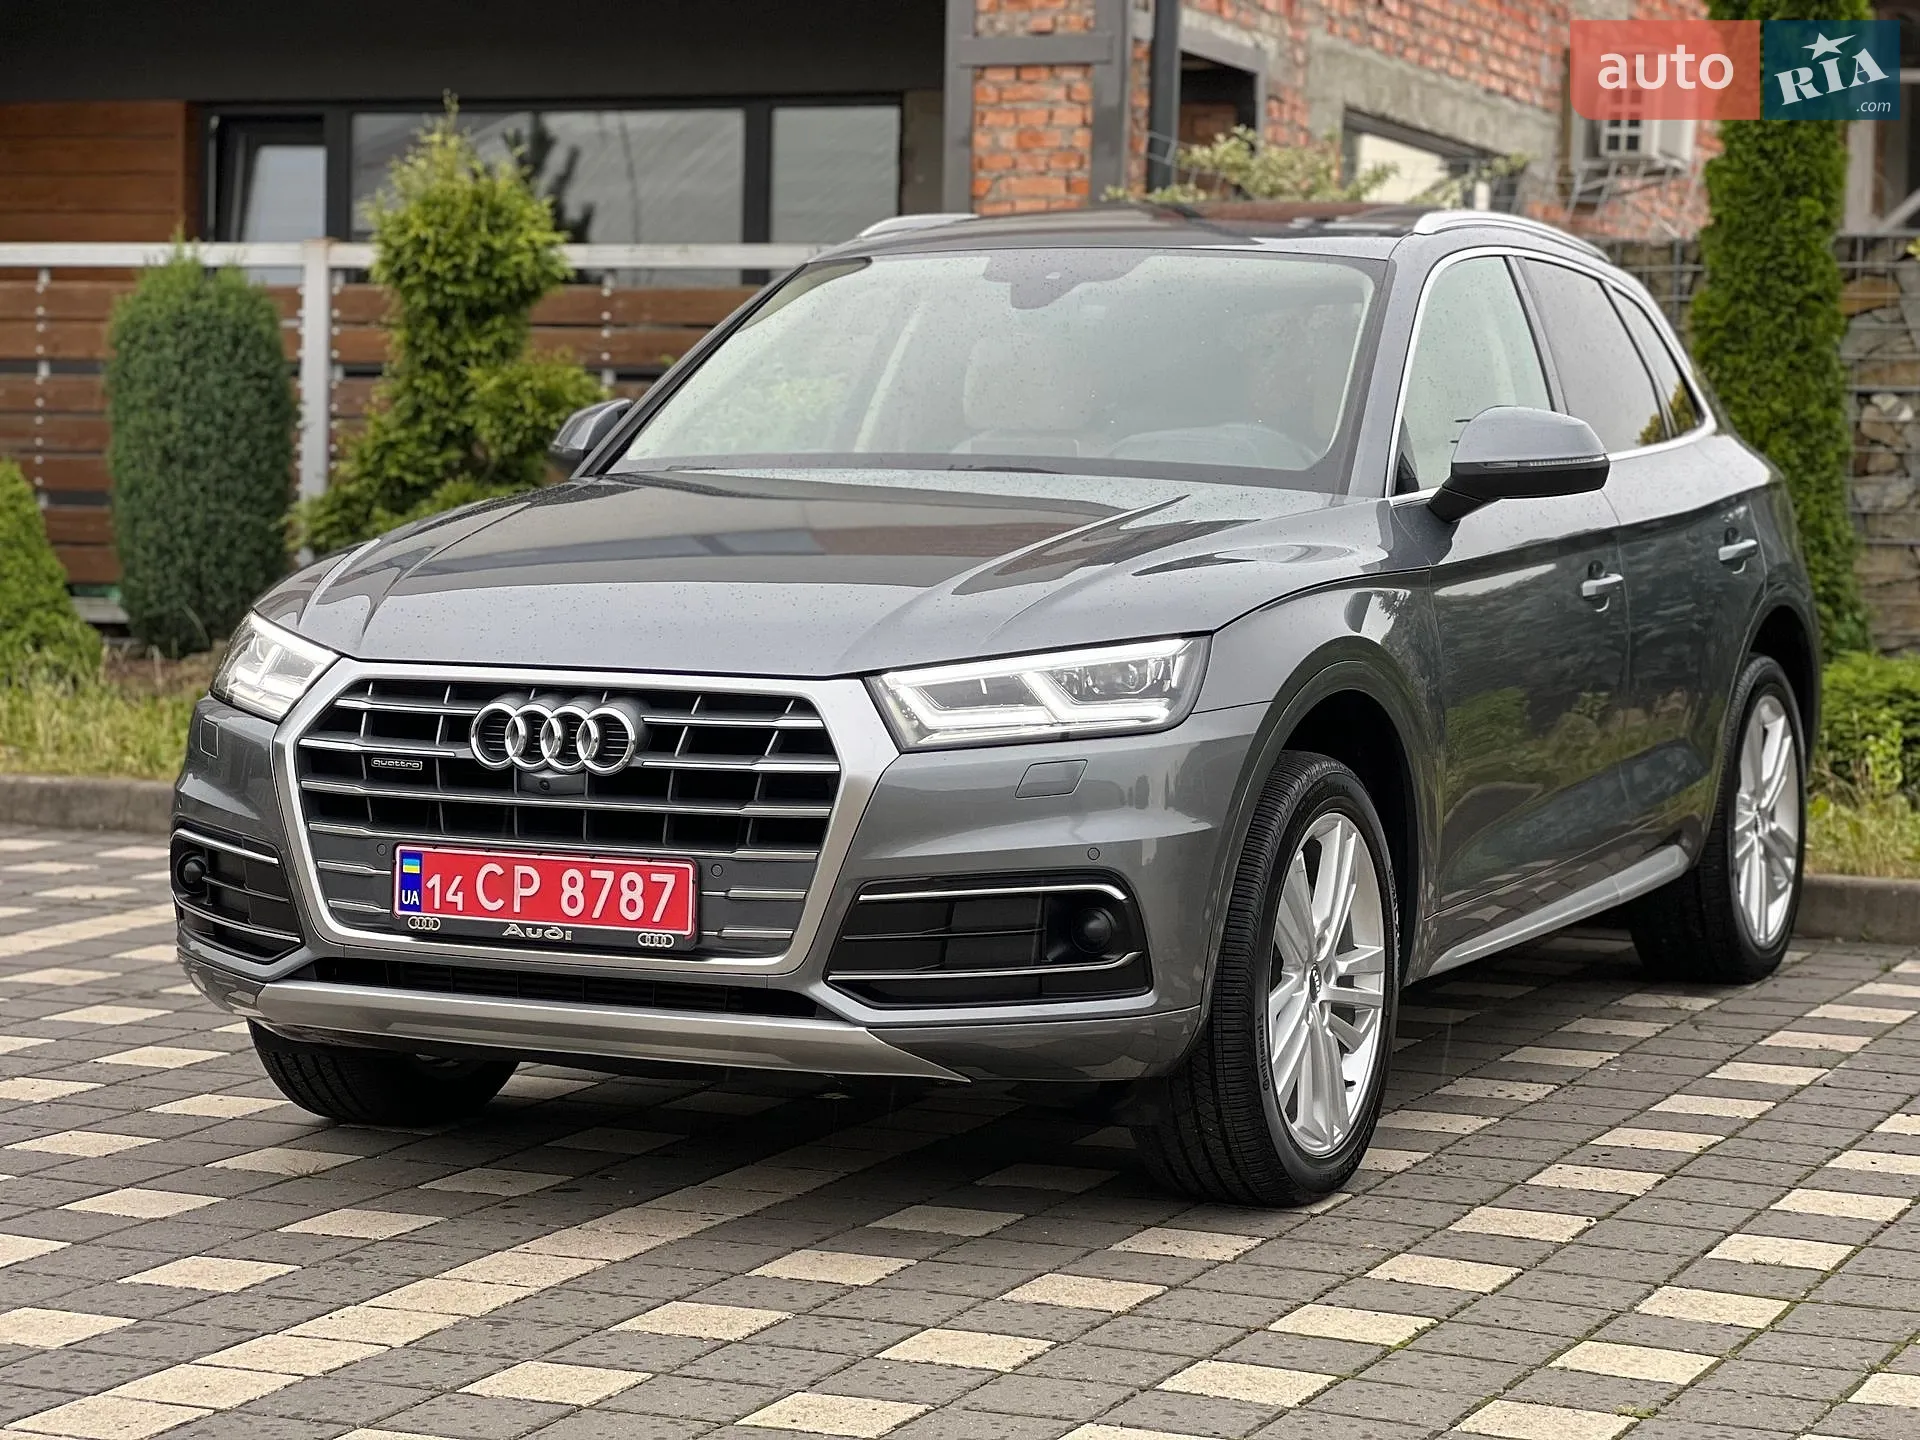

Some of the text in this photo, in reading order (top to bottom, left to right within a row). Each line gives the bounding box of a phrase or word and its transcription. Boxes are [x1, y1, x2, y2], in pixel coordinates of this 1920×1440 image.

[373, 759, 420, 768] quattro
[401, 889, 420, 906] UA
[426, 863, 676, 923] 14 CP 8787
